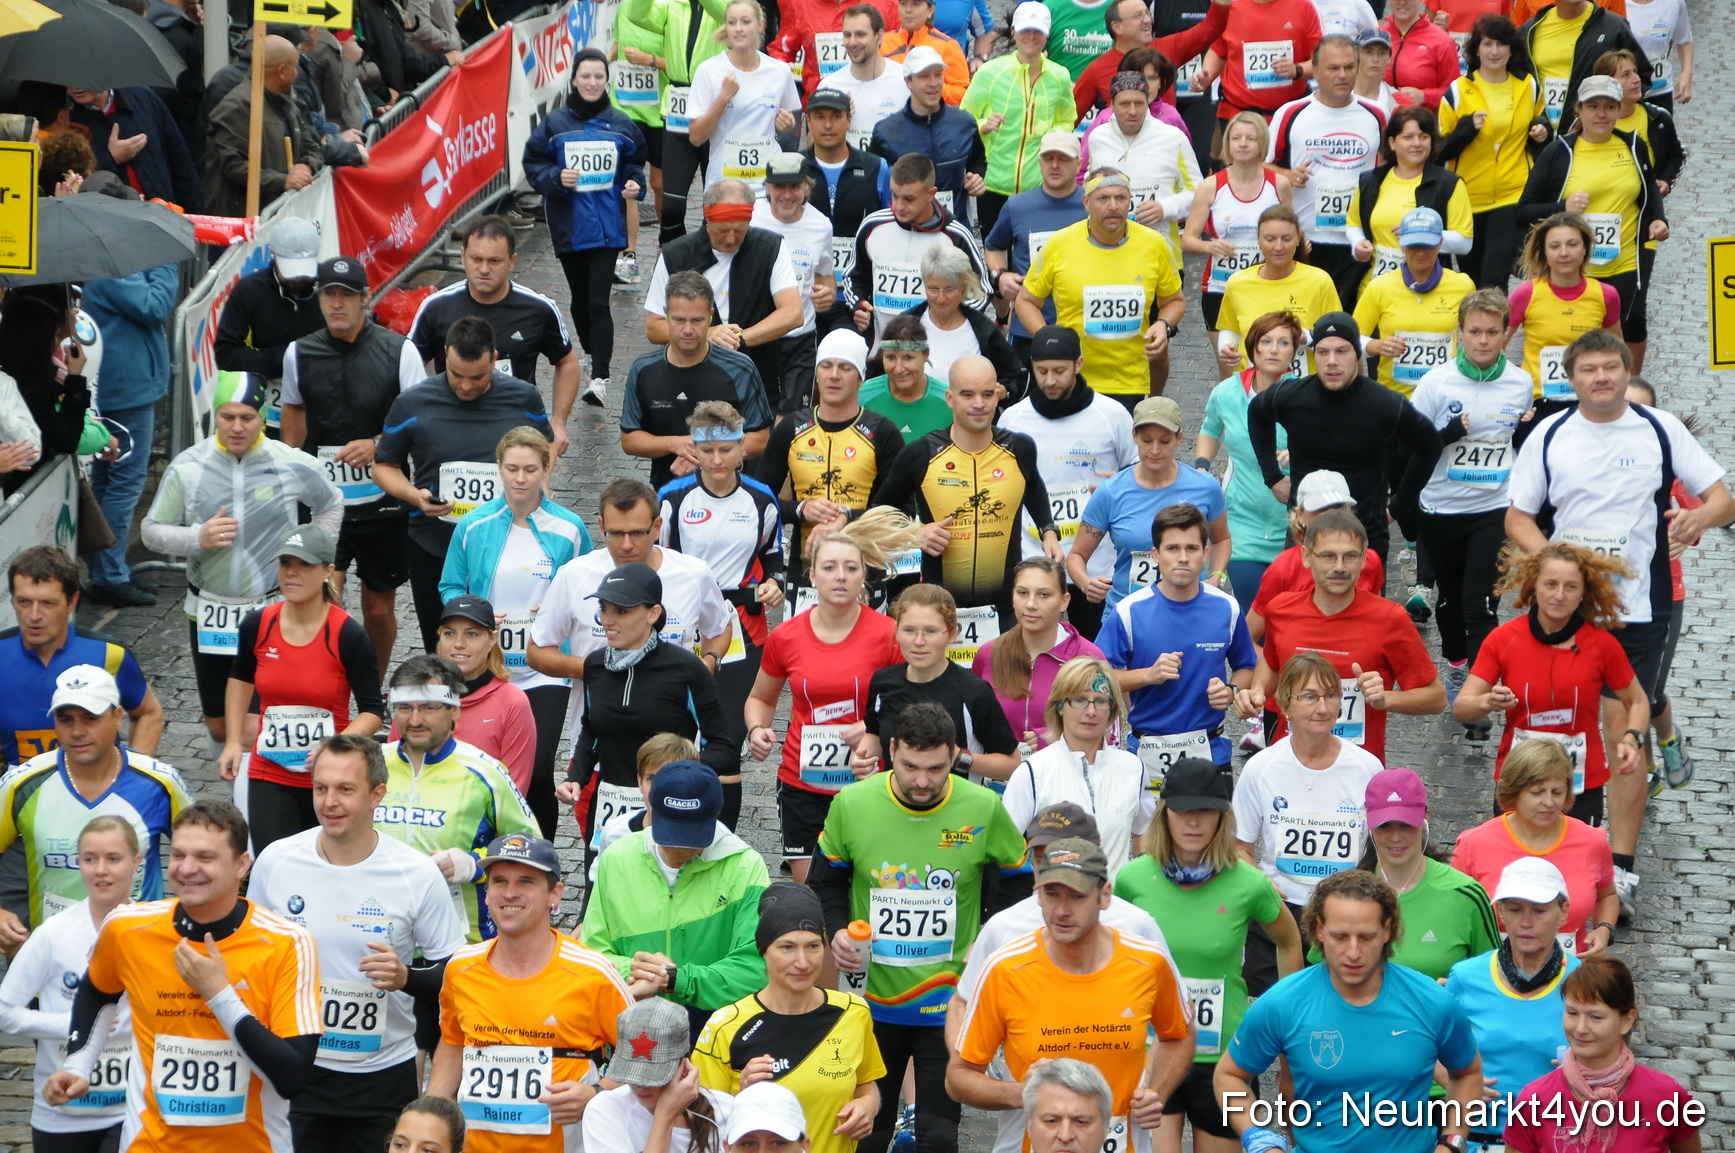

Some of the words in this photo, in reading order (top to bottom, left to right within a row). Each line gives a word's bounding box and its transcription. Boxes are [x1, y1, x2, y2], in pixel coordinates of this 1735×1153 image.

[618, 72, 655, 89] 3158
[1548, 89, 1566, 106] 24
[671, 97, 687, 115] 20
[1305, 139, 1357, 147] GERHART
[571, 154, 612, 172] 2606
[739, 149, 759, 166] 63
[878, 273, 923, 296] 2712
[885, 298, 912, 308] Richard
[1090, 299, 1140, 319] 2359
[1102, 323, 1127, 333] Martin
[1400, 346, 1448, 367] 2259
[1453, 445, 1507, 468] 2477
[1460, 471, 1498, 481] Johanna
[453, 477, 495, 502] 393
[687, 509, 705, 520] tkn
[1052, 499, 1078, 521] 20
[283, 711, 319, 721] Neumarkt
[265, 721, 327, 749] 3194
[1163, 737, 1196, 749] Neumarkt
[599, 789, 618, 800] PARTL
[667, 799, 697, 808] SAACKE
[1280, 815, 1306, 827] PARTL
[1308, 817, 1346, 829] Neumarkt
[1284, 828, 1353, 860] 2679
[499, 848, 531, 858] HAWAII
[1294, 861, 1339, 876] Cornelia
[872, 895, 898, 906] PARTL
[900, 898, 941, 906] Neumarkt
[878, 907, 948, 938] 2575
[895, 943, 928, 957] Oliver
[156, 990, 186, 1000] Verein
[331, 986, 373, 999] Neumarkt
[155, 1008, 187, 1018] Altdorf
[323, 999, 378, 1031] 028
[474, 1023, 501, 1036] Verein
[502, 1026, 517, 1036] der
[519, 1026, 556, 1040] Notärzte
[1040, 1026, 1071, 1037] Verein
[1073, 1025, 1090, 1035] der
[1092, 1022, 1132, 1034] Notärzte
[826, 1038, 843, 1046] TSV
[1037, 1042, 1071, 1053] Altdorf
[1079, 1041, 1113, 1051] Feucht
[1115, 1041, 1132, 1051] e.V.
[155, 1043, 185, 1055] PARTL
[187, 1045, 234, 1058] Neumarkt
[492, 1055, 535, 1067] Neumarkt
[159, 1058, 238, 1093] 2981
[817, 1066, 856, 1081] Burgthann
[467, 1067, 543, 1101] 2916
[169, 1098, 226, 1115] Christian
[484, 1107, 523, 1123] Rainer
